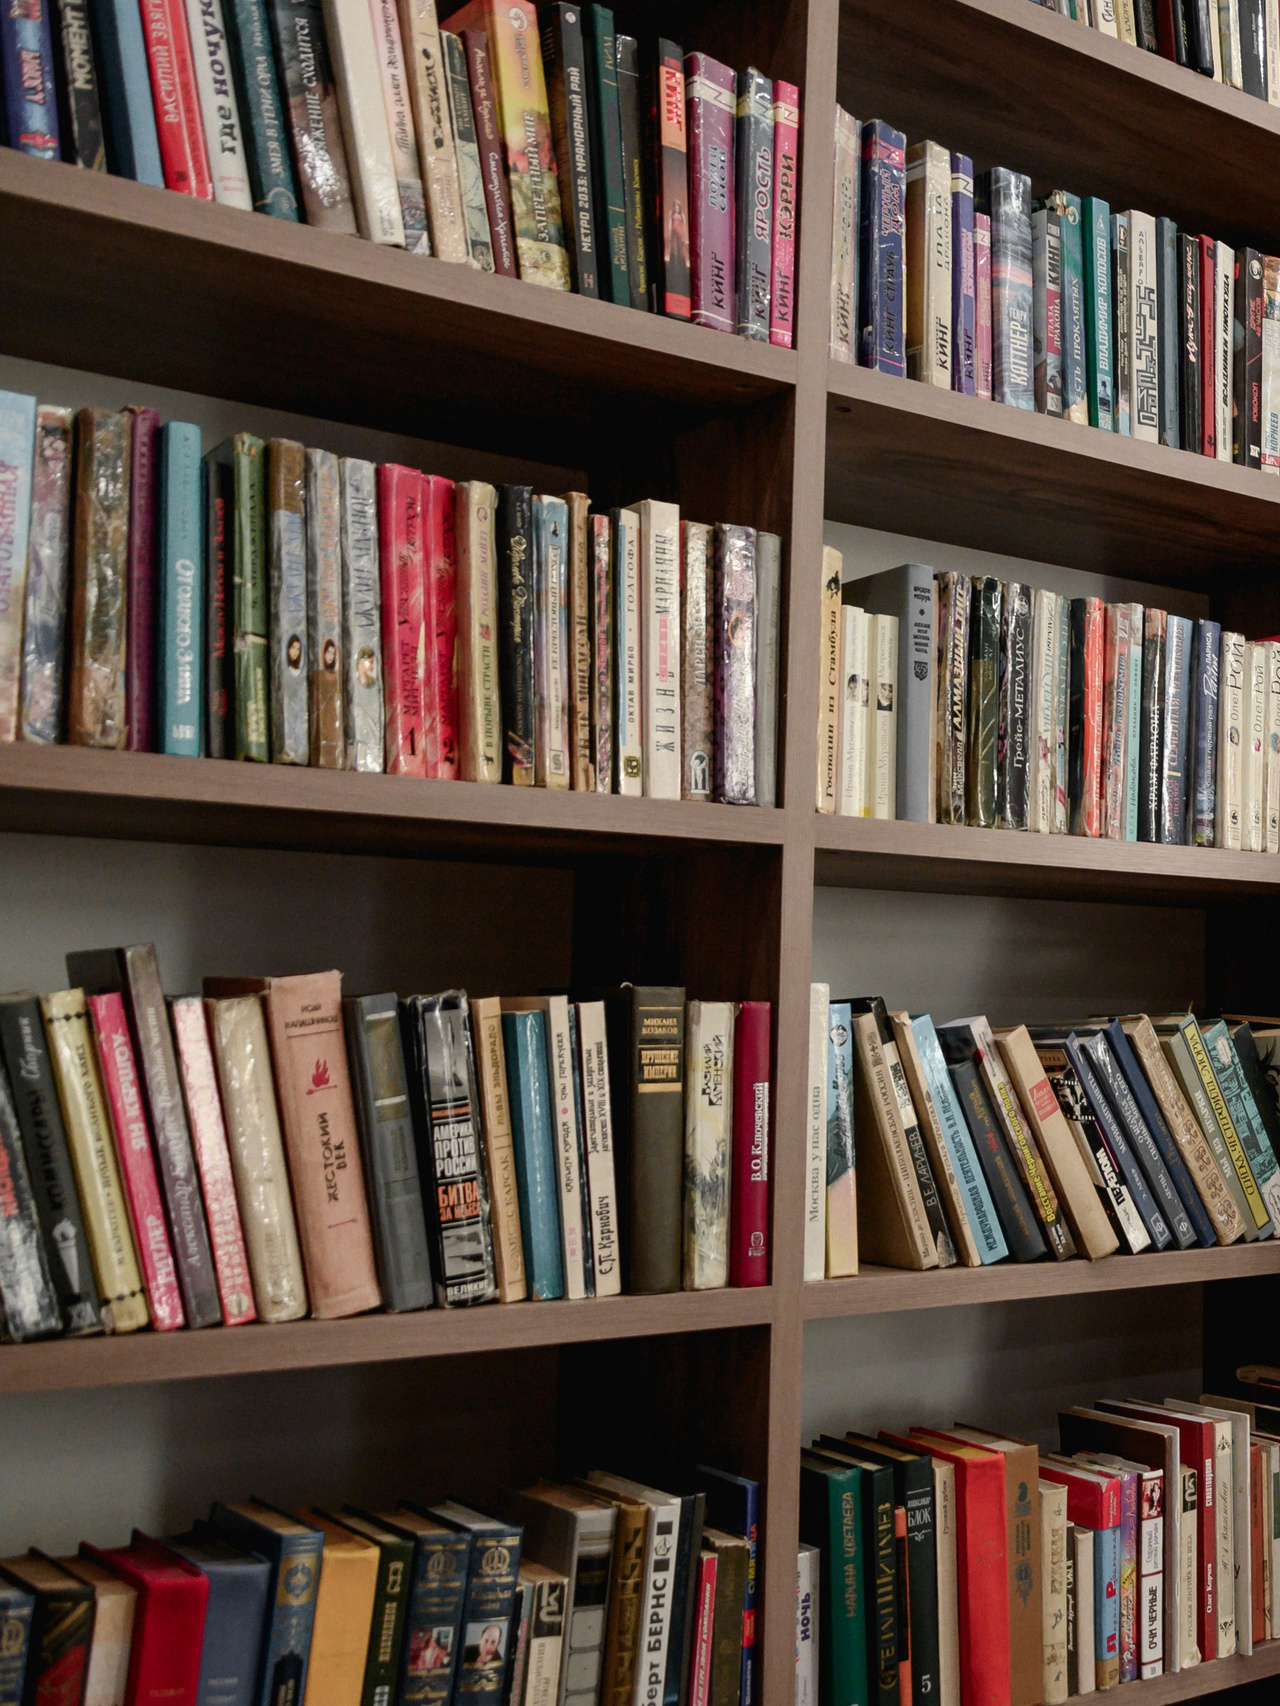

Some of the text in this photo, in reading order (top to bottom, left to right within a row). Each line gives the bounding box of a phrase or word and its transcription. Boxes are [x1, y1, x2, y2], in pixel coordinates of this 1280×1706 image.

[66, 5, 93, 90] МОМЕНТ
[295, 17, 317, 88] СХОДИТСЯ
[602, 35, 614, 70] КИМ
[218, 105, 237, 155] где
[567, 66, 592, 252] МЕТРО МРАМОРНЫЙ РАЙ
[778, 150, 794, 239] КЭРРИ
[754, 146, 771, 321] КИНГ ЯРОСТЬ
[711, 251, 726, 310] КИНГ
[883, 250, 896, 355] КИНГ СТРАУБ
[1047, 240, 1060, 339] ГЛАЗА КИНГ
[1096, 236, 1109, 371] ВЛАДИМИР КОЛОСОВ
[1051, 297, 1061, 351] ДРАКОНА
[1069, 276, 1081, 360] ПРОКЛЯТЫХ
[1222, 273, 1230, 408] ВСАДНИКИ НИОТКУДА
[1009, 319, 1028, 387] КАТТНЕР
[1269, 412, 1278, 452] КОРНЕЕВ
[655, 533, 674, 615] МАРИАННЫ
[626, 539, 635, 723] ОКТАВ МИРБО ГОЛГОФА
[952, 584, 964, 730] АЛМАЗНЫЙ ТИГР
[1205, 632, 1213, 663] ЛАРИСА
[826, 610, 837, 799] Господин из Стамбула
[1014, 627, 1024, 718] МЕТАЛИУС
[1254, 664, 1264, 694] Рой
[956, 742, 964, 795] Максвелл
[1148, 704, 1160, 810] ХРАМ ФАРАОНА
[1207, 721, 1215, 753] первый
[878, 769, 888, 806] Ирина
[1129, 756, 1137, 806] Набокова
[702, 1042, 713, 1095] ВАСИЛИЙ
[708, 1034, 724, 1107] КАМЕНСКИЙ
[1189, 1033, 1209, 1077] МОРУА
[751, 1082, 764, 1155] Ключевский
[996, 1081, 1013, 1110] полка
[129, 1121, 150, 1150] ЯН
[317, 1111, 339, 1202] ЖЕСТОКИЙ
[333, 1140, 348, 1170] ВЕК
[809, 1085, 822, 1223] Москва нас одна
[1006, 1109, 1038, 1176] Черниговского
[1194, 1089, 1233, 1178] МЫ ИГАРКИ
[596, 1195, 615, 1249] Карнович
[949, 1128, 998, 1252] МЕЖДУНАРОДНАЯ ДЕЯТЕЛЬНОСТЬ
[1031, 1175, 1057, 1223] Восстание
[840, 1491, 857, 1617] МАРИНА ЦВЕТАЕВА
[646, 1578, 667, 1653] БЕРНС
[800, 1592, 810, 1641] НОЧЬ
[1148, 1585, 1158, 1650] ОЧИ ЧЕРНЫЕ
[1205, 1593, 1213, 1613] Олег
[921, 1673, 932, 1694] 5
